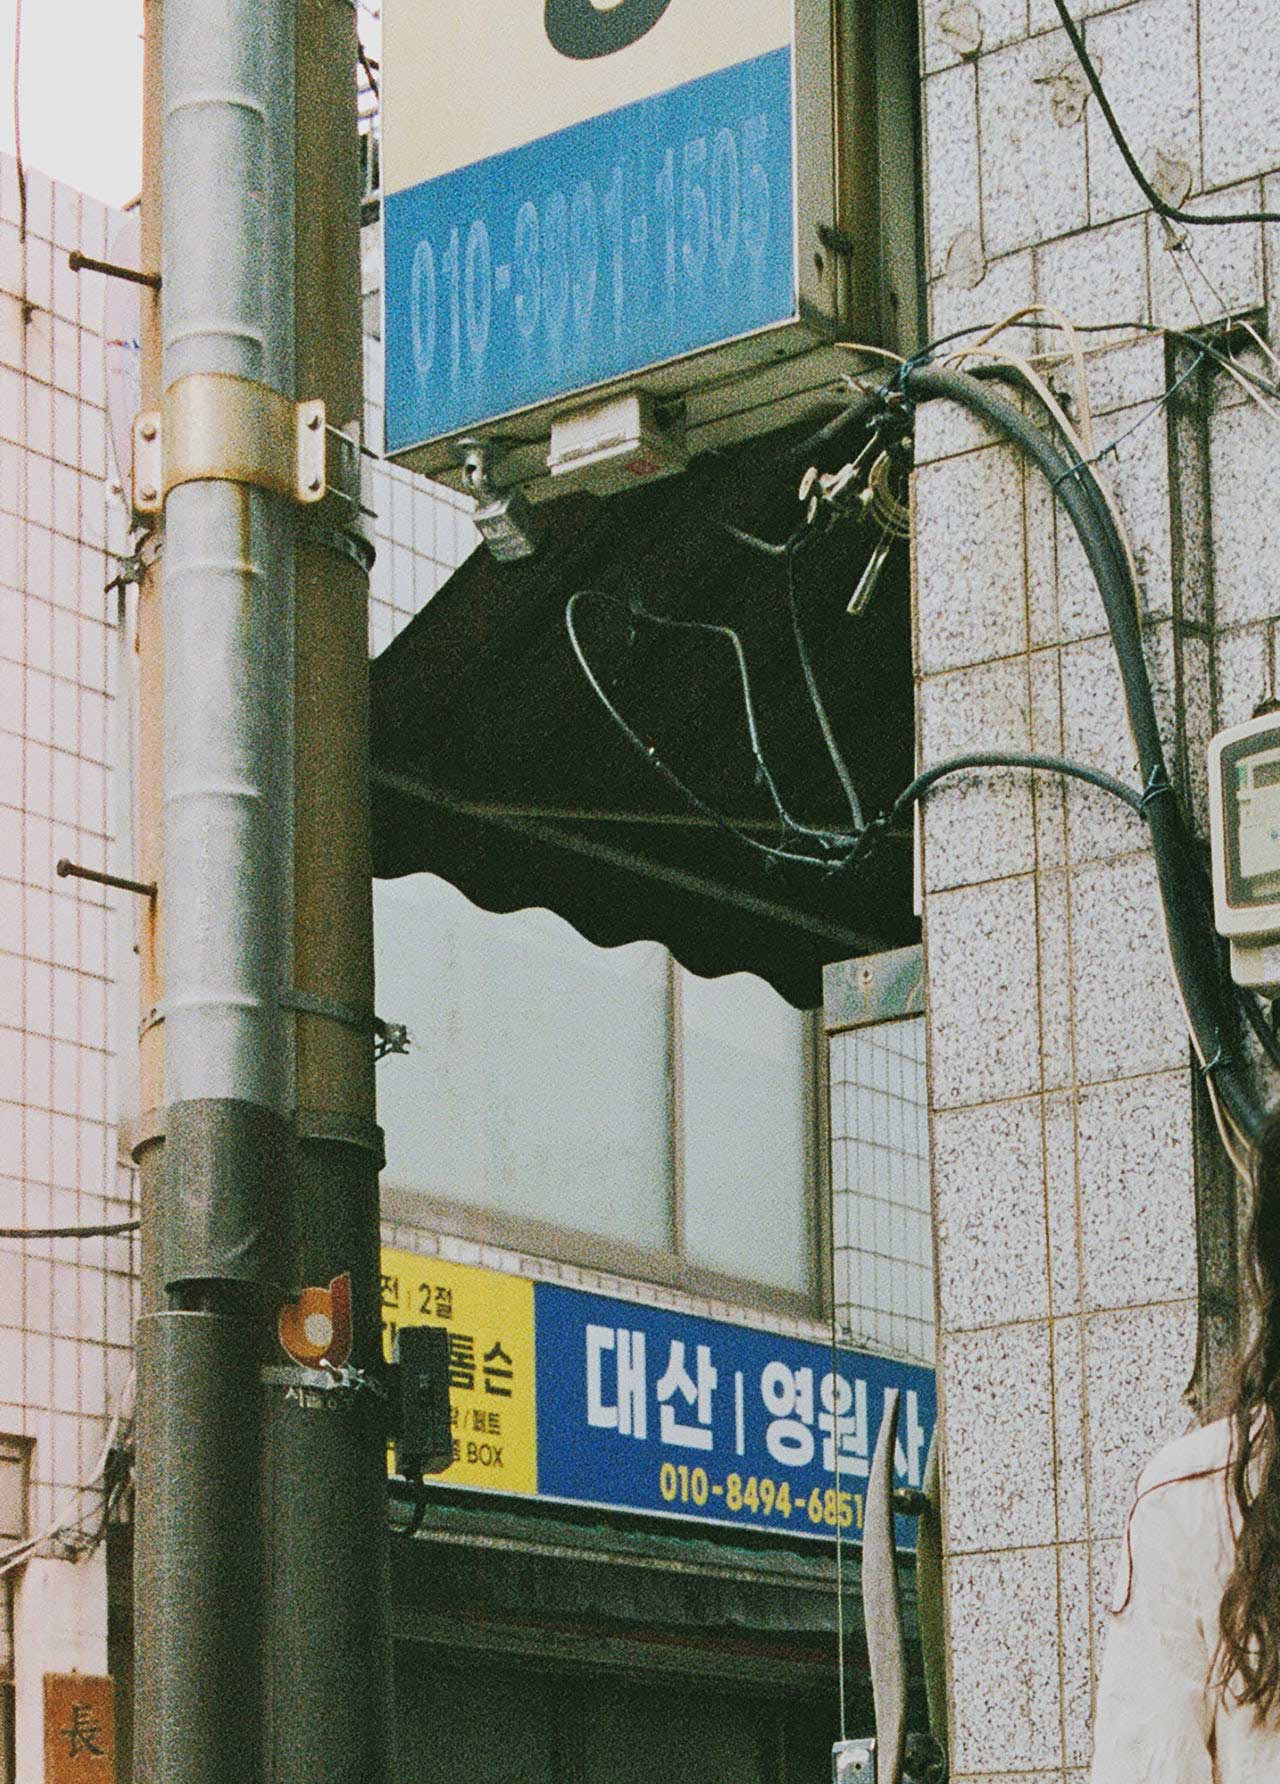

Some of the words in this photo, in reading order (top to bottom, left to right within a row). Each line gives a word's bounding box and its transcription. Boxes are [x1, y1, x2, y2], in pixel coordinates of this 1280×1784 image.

[419, 1282, 453, 1320] 2절
[585, 1323, 717, 1452] 대산
[760, 1360, 925, 1487] 영원사
[467, 1441, 504, 1469] BOX
[659, 1462, 865, 1528] 010-8494-6851
